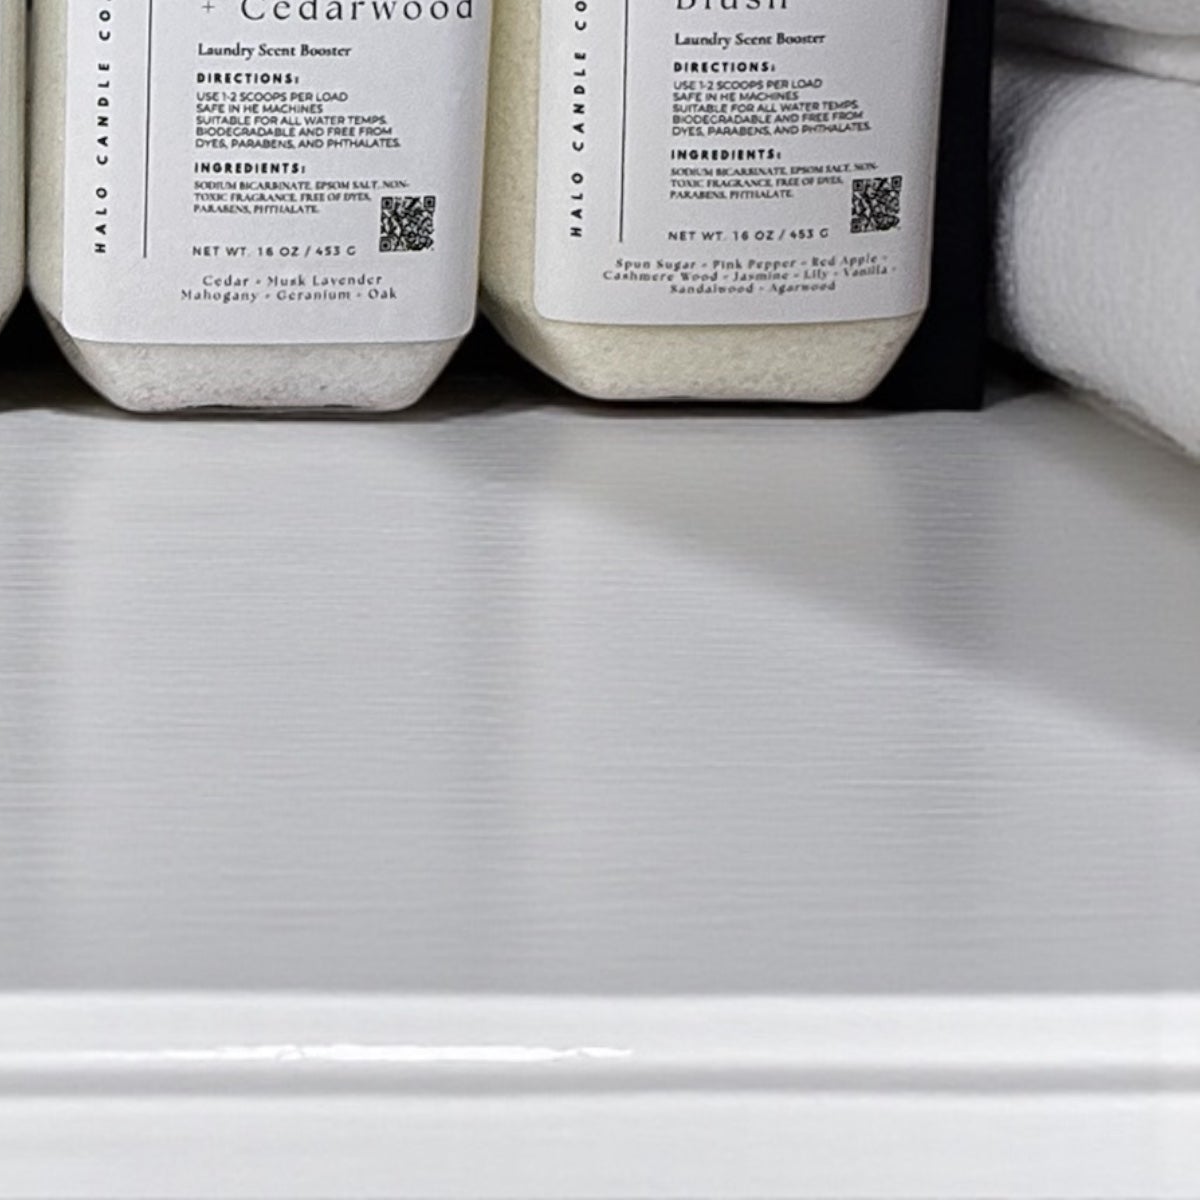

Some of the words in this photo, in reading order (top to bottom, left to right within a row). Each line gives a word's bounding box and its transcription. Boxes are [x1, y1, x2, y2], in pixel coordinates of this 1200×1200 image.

[674, 32, 732, 48] Laundry
[734, 32, 773, 46] Scent
[776, 32, 825, 45] Booster
[198, 42, 255, 60] Laundry
[258, 43, 296, 57] Scent
[300, 44, 351, 57] Booster
[673, 61, 775, 74] DIRECTIONS:
[196, 72, 299, 85] DIRECTIONS:
[196, 91, 220, 102] USE
[239, 92, 288, 102] SCOOPS
[289, 92, 314, 102] PER
[316, 92, 348, 102] LOAD
[572, 52, 586, 152] CANDLE
[96, 63, 110, 166] CANDLE
[196, 103, 226, 114] SAFE
[228, 104, 241, 114] IN
[242, 103, 260, 114] HE
[262, 103, 324, 114] MACHINES
[671, 148, 781, 161] INGREDIENTS:
[194, 162, 306, 174] INGREDIENTS:
[570, 172, 584, 237] HALO
[94, 187, 108, 253] HALO
[668, 230, 696, 242] NET
[733, 230, 749, 242] 16
[754, 230, 774, 241] OZ
[790, 229, 814, 240] 453
[819, 228, 829, 239] G
[192, 246, 220, 257] NET
[279, 246, 300, 257] OZ
[315, 246, 341, 256] 453
[346, 245, 356, 256] G
[202, 274, 249, 287] Cedar
[267, 274, 306, 287] Musk
[312, 273, 382, 287] Lavender
[181, 288, 258, 302] Mahogany
[276, 289, 351, 301] Geranium
[368, 287, 396, 300] Oak
